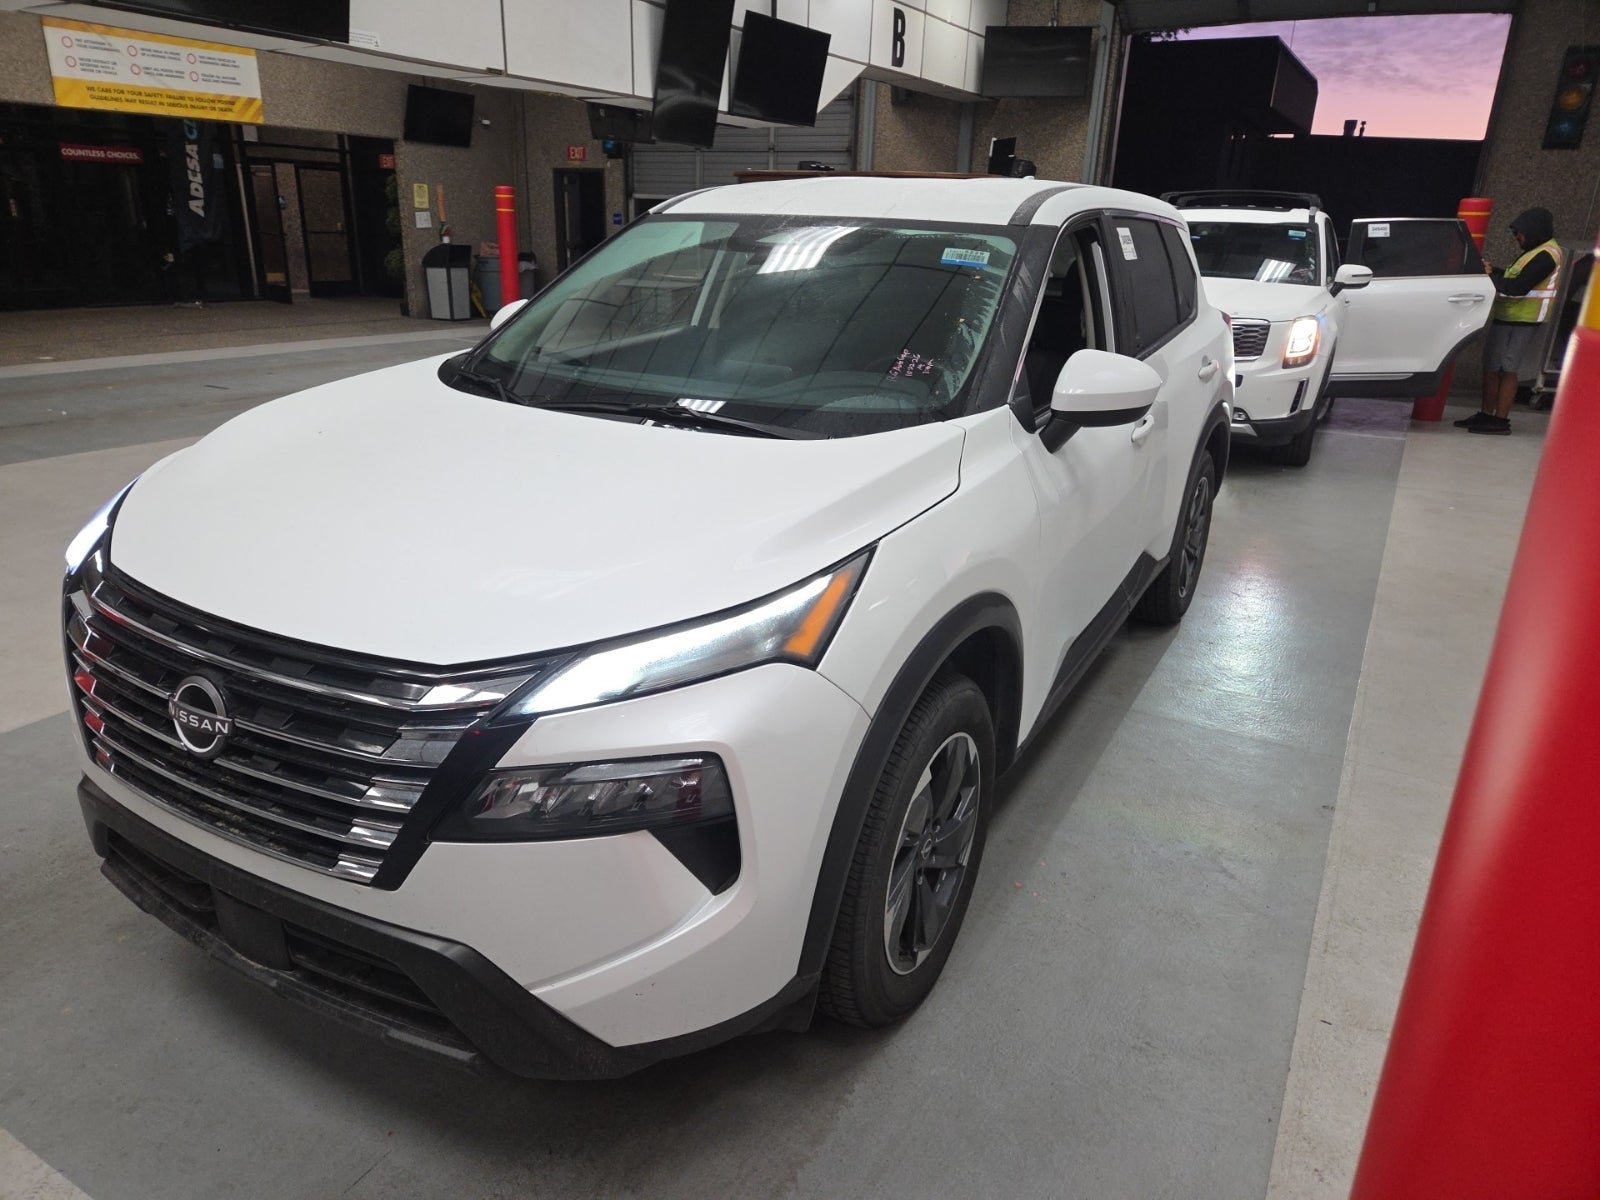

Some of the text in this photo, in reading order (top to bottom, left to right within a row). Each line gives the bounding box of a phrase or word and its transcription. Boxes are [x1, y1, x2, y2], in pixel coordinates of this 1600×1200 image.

[891, 7, 906, 68] B
[61, 148, 105, 158] COUNTLESS
[569, 146, 584, 160] EXIT
[184, 144, 205, 217] ADESA
[168, 701, 229, 734] NISSAN
